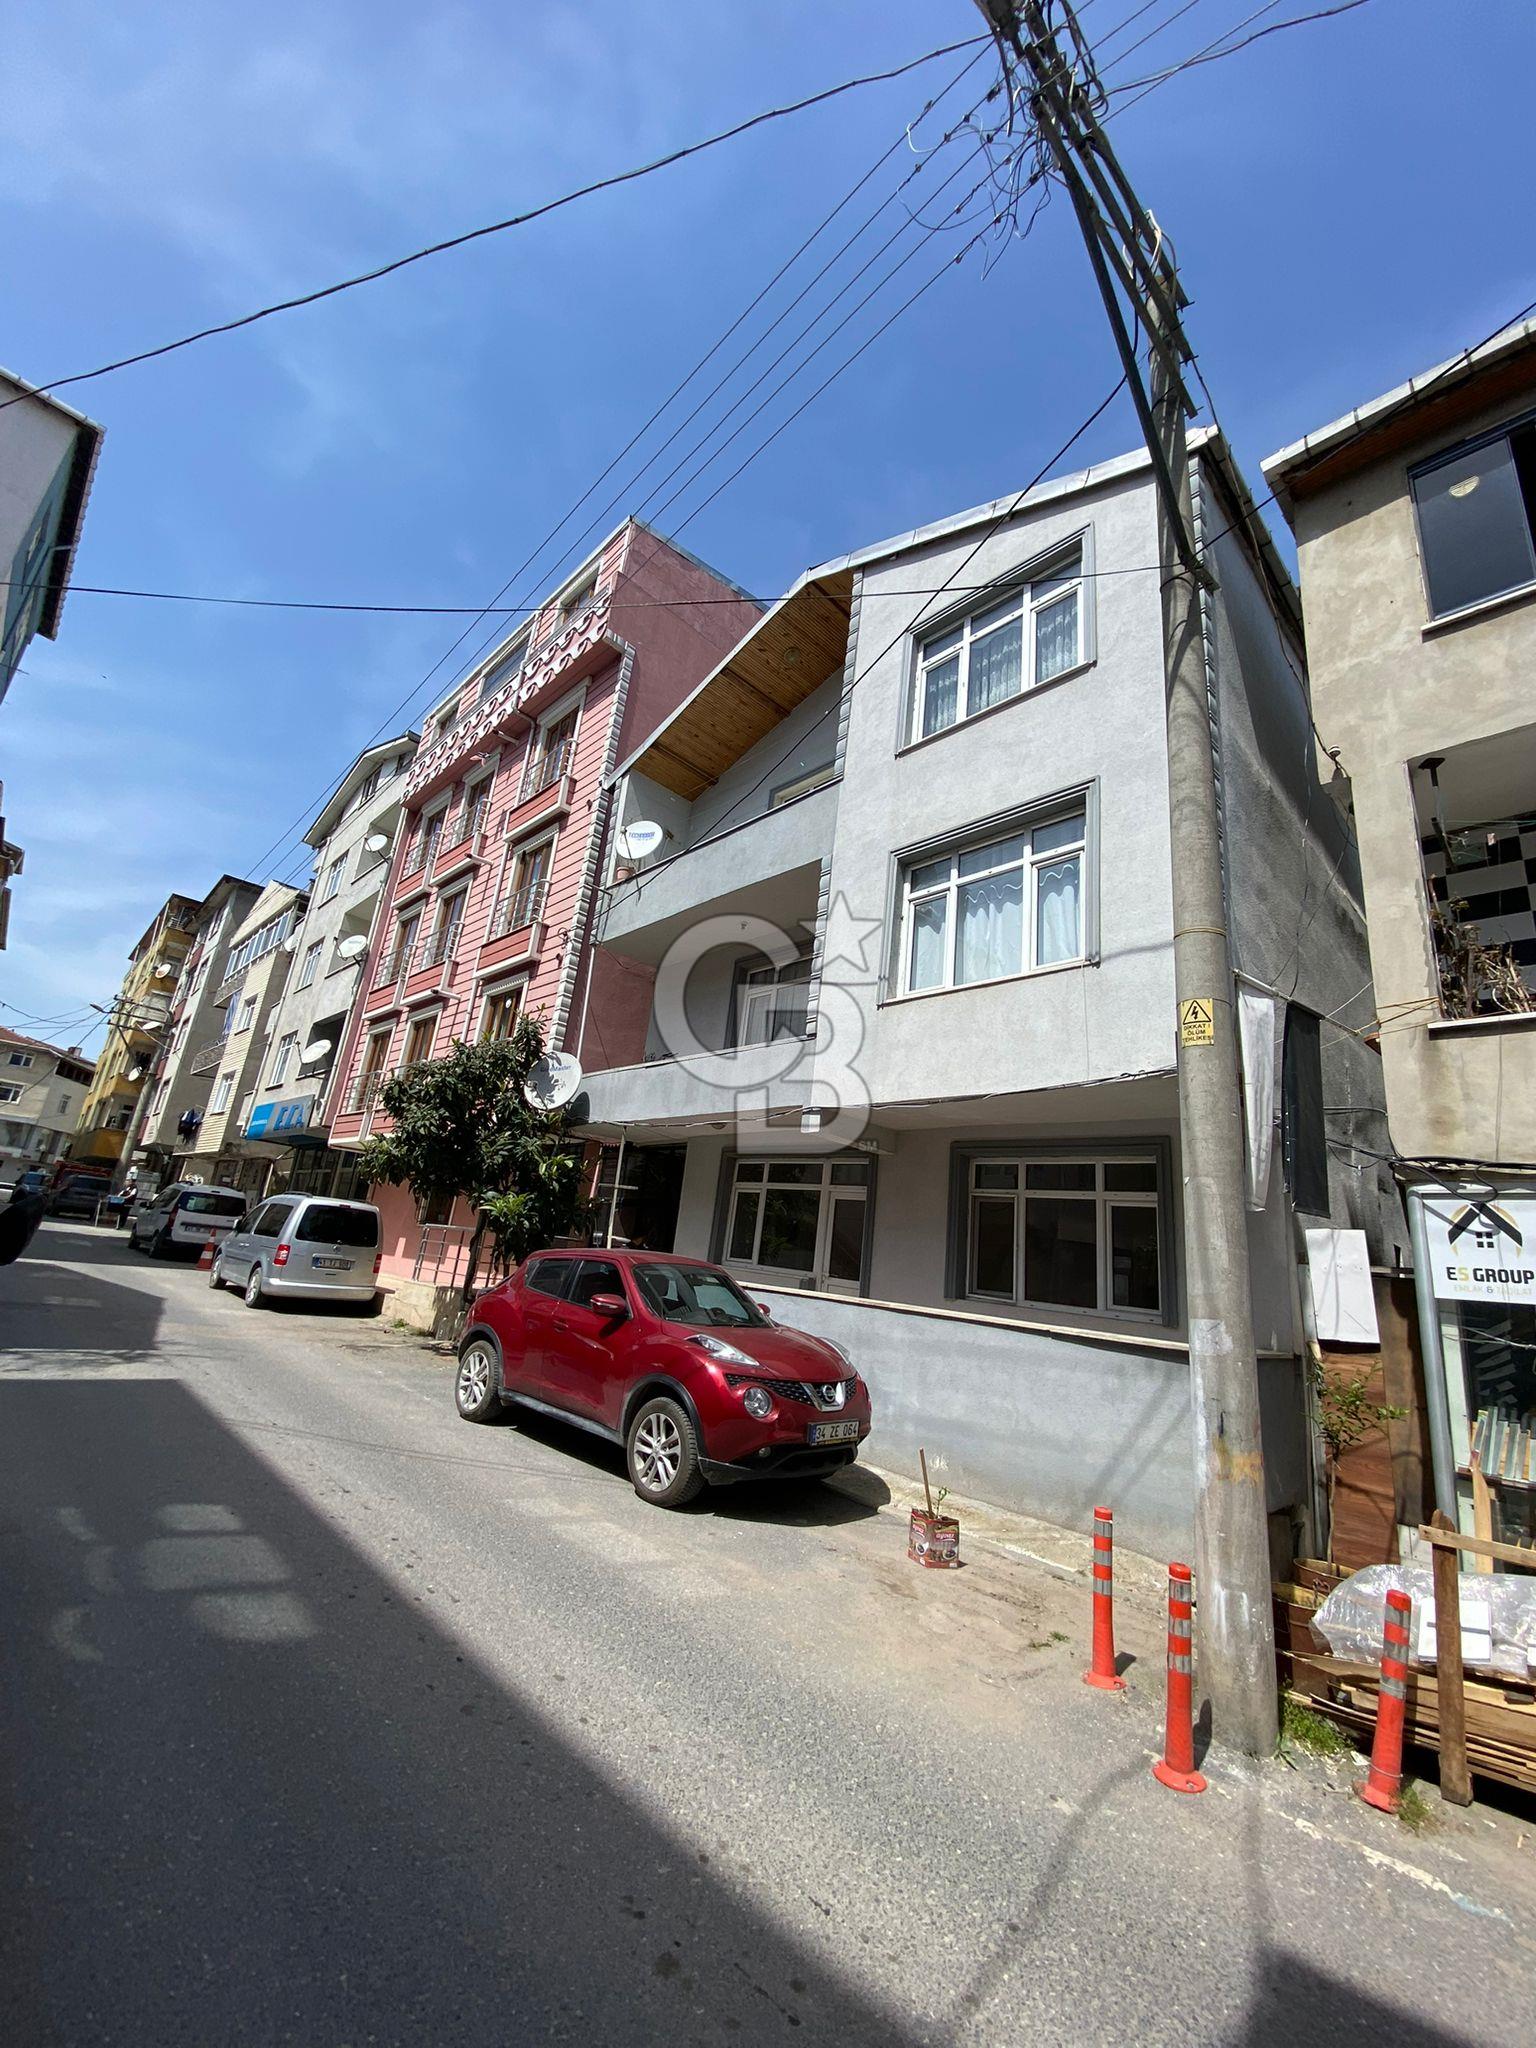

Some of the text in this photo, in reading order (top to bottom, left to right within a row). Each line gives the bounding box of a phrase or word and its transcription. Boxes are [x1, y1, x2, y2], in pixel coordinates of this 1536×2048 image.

[1446, 1266, 1534, 1284] ES GROUP
[816, 1423, 857, 1440] 34 ZE 064
